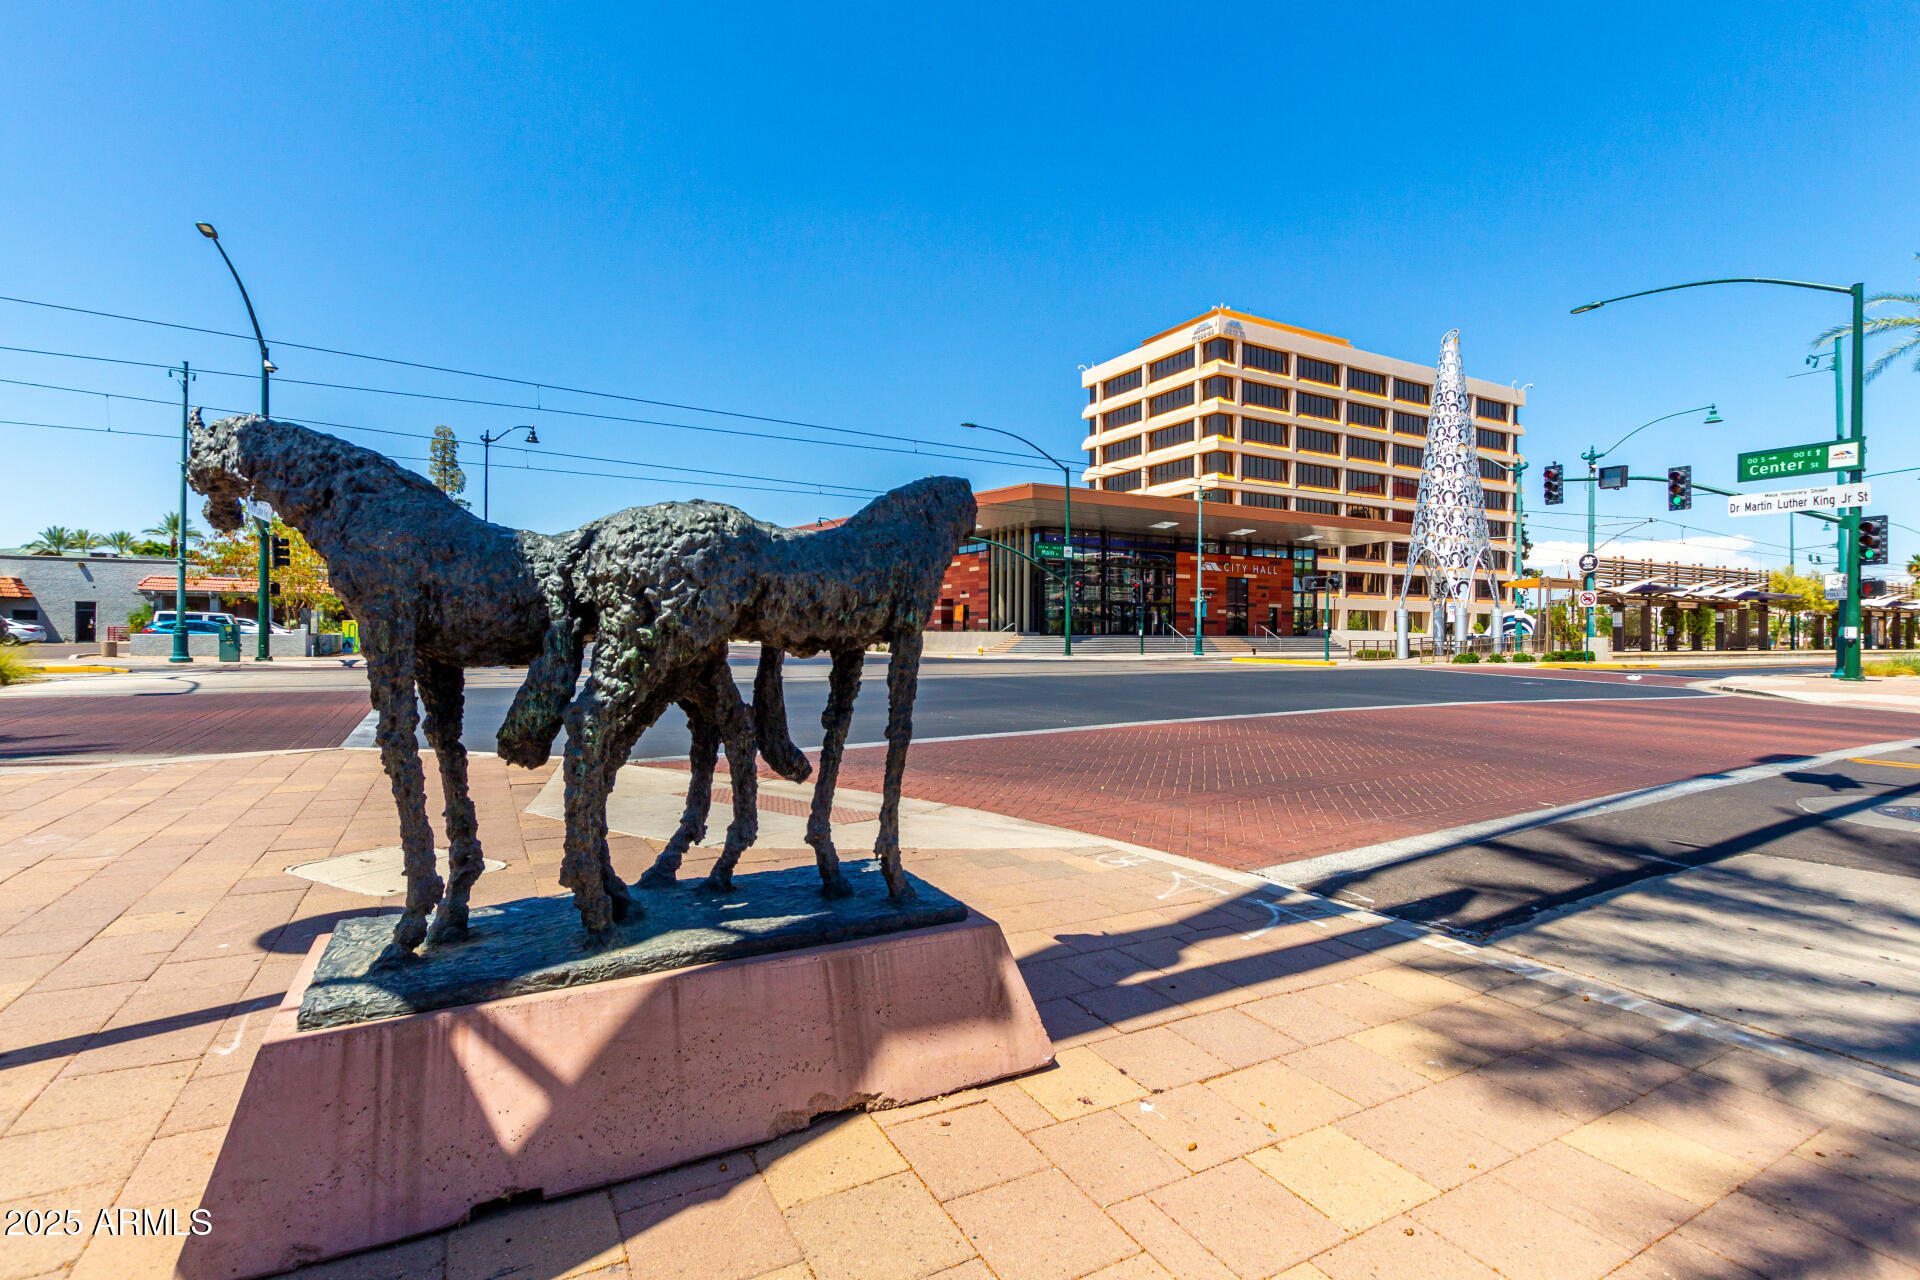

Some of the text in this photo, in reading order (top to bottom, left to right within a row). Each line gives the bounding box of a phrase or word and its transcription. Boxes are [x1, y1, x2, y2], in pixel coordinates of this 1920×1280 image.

[1749, 460, 1805, 476] Center
[1730, 491, 1868, 513] Dr Martin Luther King Jr St
[1223, 562, 1278, 575] CITY HALL
